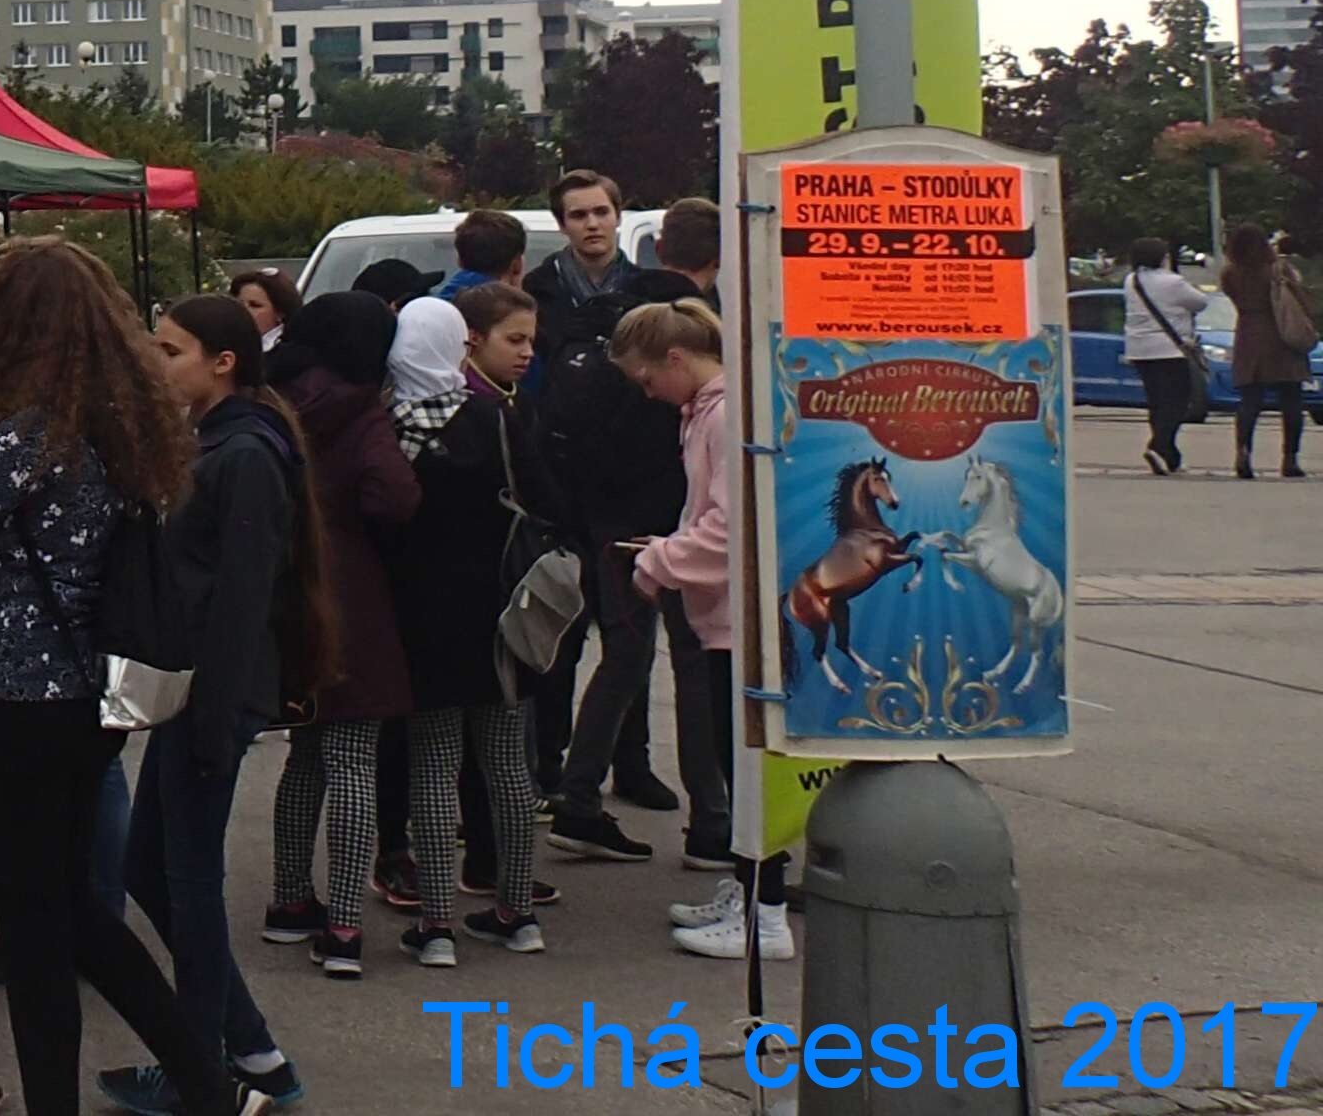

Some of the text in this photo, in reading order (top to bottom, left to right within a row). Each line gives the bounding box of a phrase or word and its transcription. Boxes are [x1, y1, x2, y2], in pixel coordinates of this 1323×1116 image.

[795, 175, 874, 197] PRAHA
[903, 170, 1013, 199] STODŮLKY
[797, 204, 1014, 226] STANICE METRA LUKA
[924, 263, 937, 271] od
[924, 274, 937, 282] od
[974, 274, 993, 282] hod
[974, 285, 995, 293] hod
[816, 321, 1003, 334] www.berousek.cz
[850, 364, 991, 384] NÁRODNÍ CIRKUS
[809, 388, 909, 417] Original
